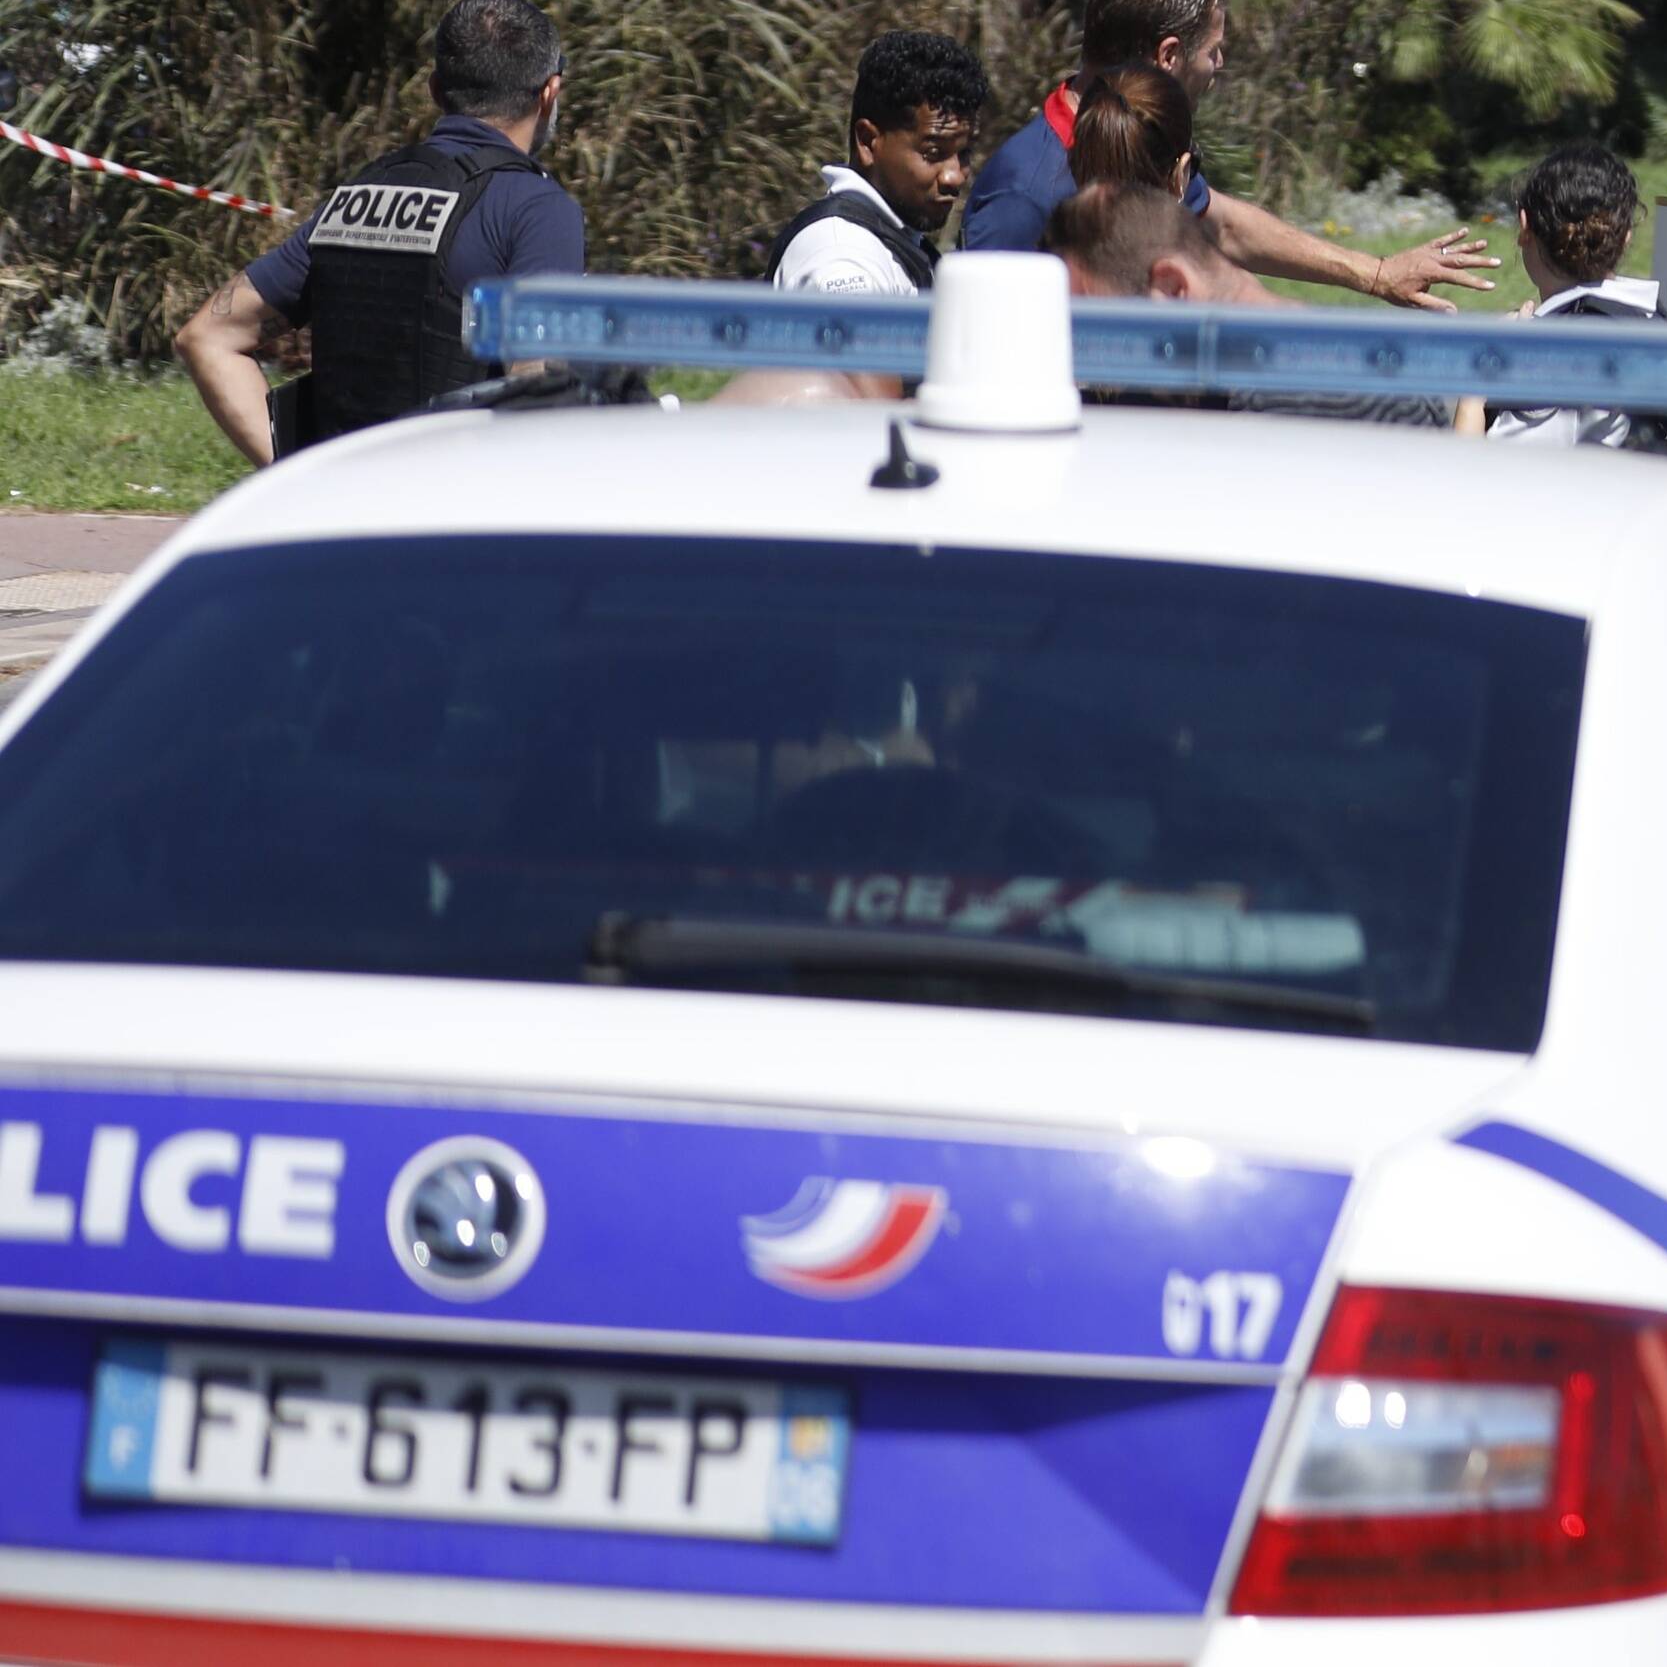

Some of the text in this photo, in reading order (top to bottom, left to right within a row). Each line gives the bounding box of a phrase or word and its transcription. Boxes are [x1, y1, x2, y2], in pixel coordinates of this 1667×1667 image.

[321, 188, 449, 232] POLICE
[826, 275, 865, 290] POLICE
[0, 1119, 347, 1260] LICE
